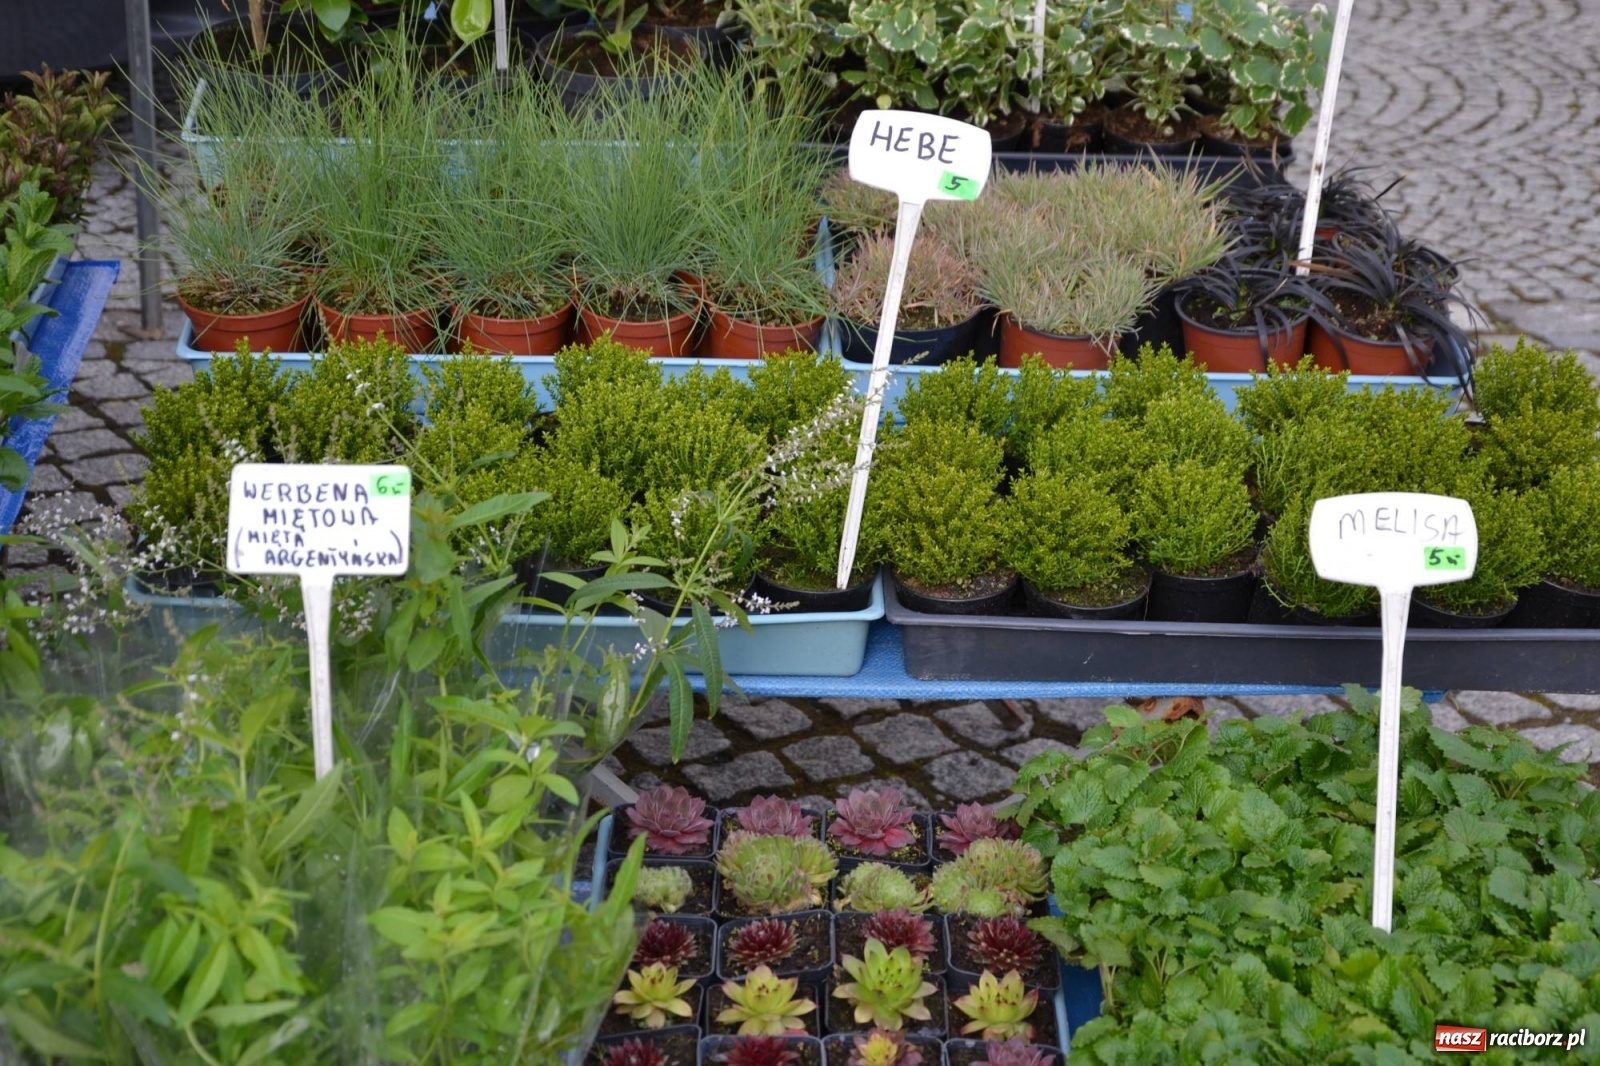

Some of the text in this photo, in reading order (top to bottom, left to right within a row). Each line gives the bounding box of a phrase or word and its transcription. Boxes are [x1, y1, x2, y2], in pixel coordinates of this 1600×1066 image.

[869, 120, 961, 164] HEBE
[243, 480, 369, 504] WERBENA
[1339, 506, 1464, 544] MELISA
